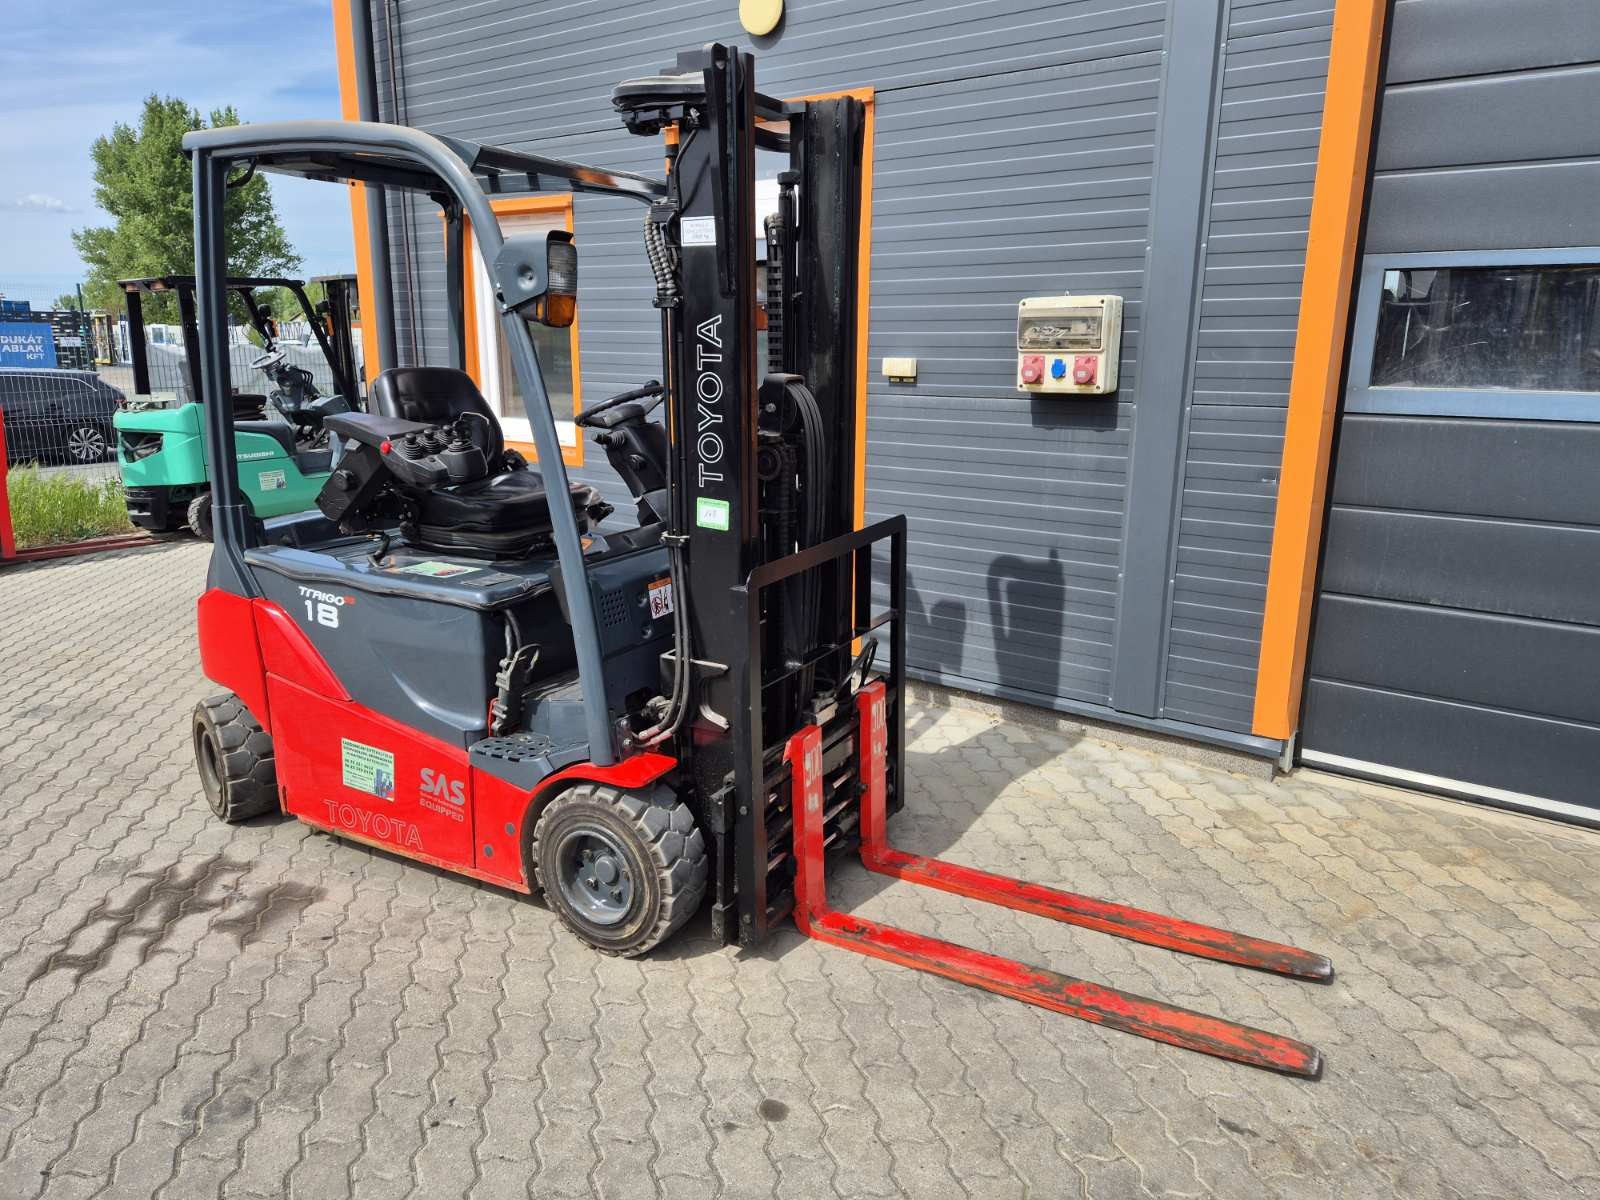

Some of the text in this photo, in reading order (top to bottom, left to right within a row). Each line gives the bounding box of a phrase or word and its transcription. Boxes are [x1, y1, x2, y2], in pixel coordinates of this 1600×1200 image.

[0, 333, 43, 344] DUKÁT
[2, 344, 44, 353] ABLAK
[697, 314, 723, 488] TOYOTA
[304, 599, 339, 629] 18
[420, 767, 465, 806] SAS
[323, 799, 424, 850] TOYOTA
[420, 798, 464, 822] EQUIPPED
